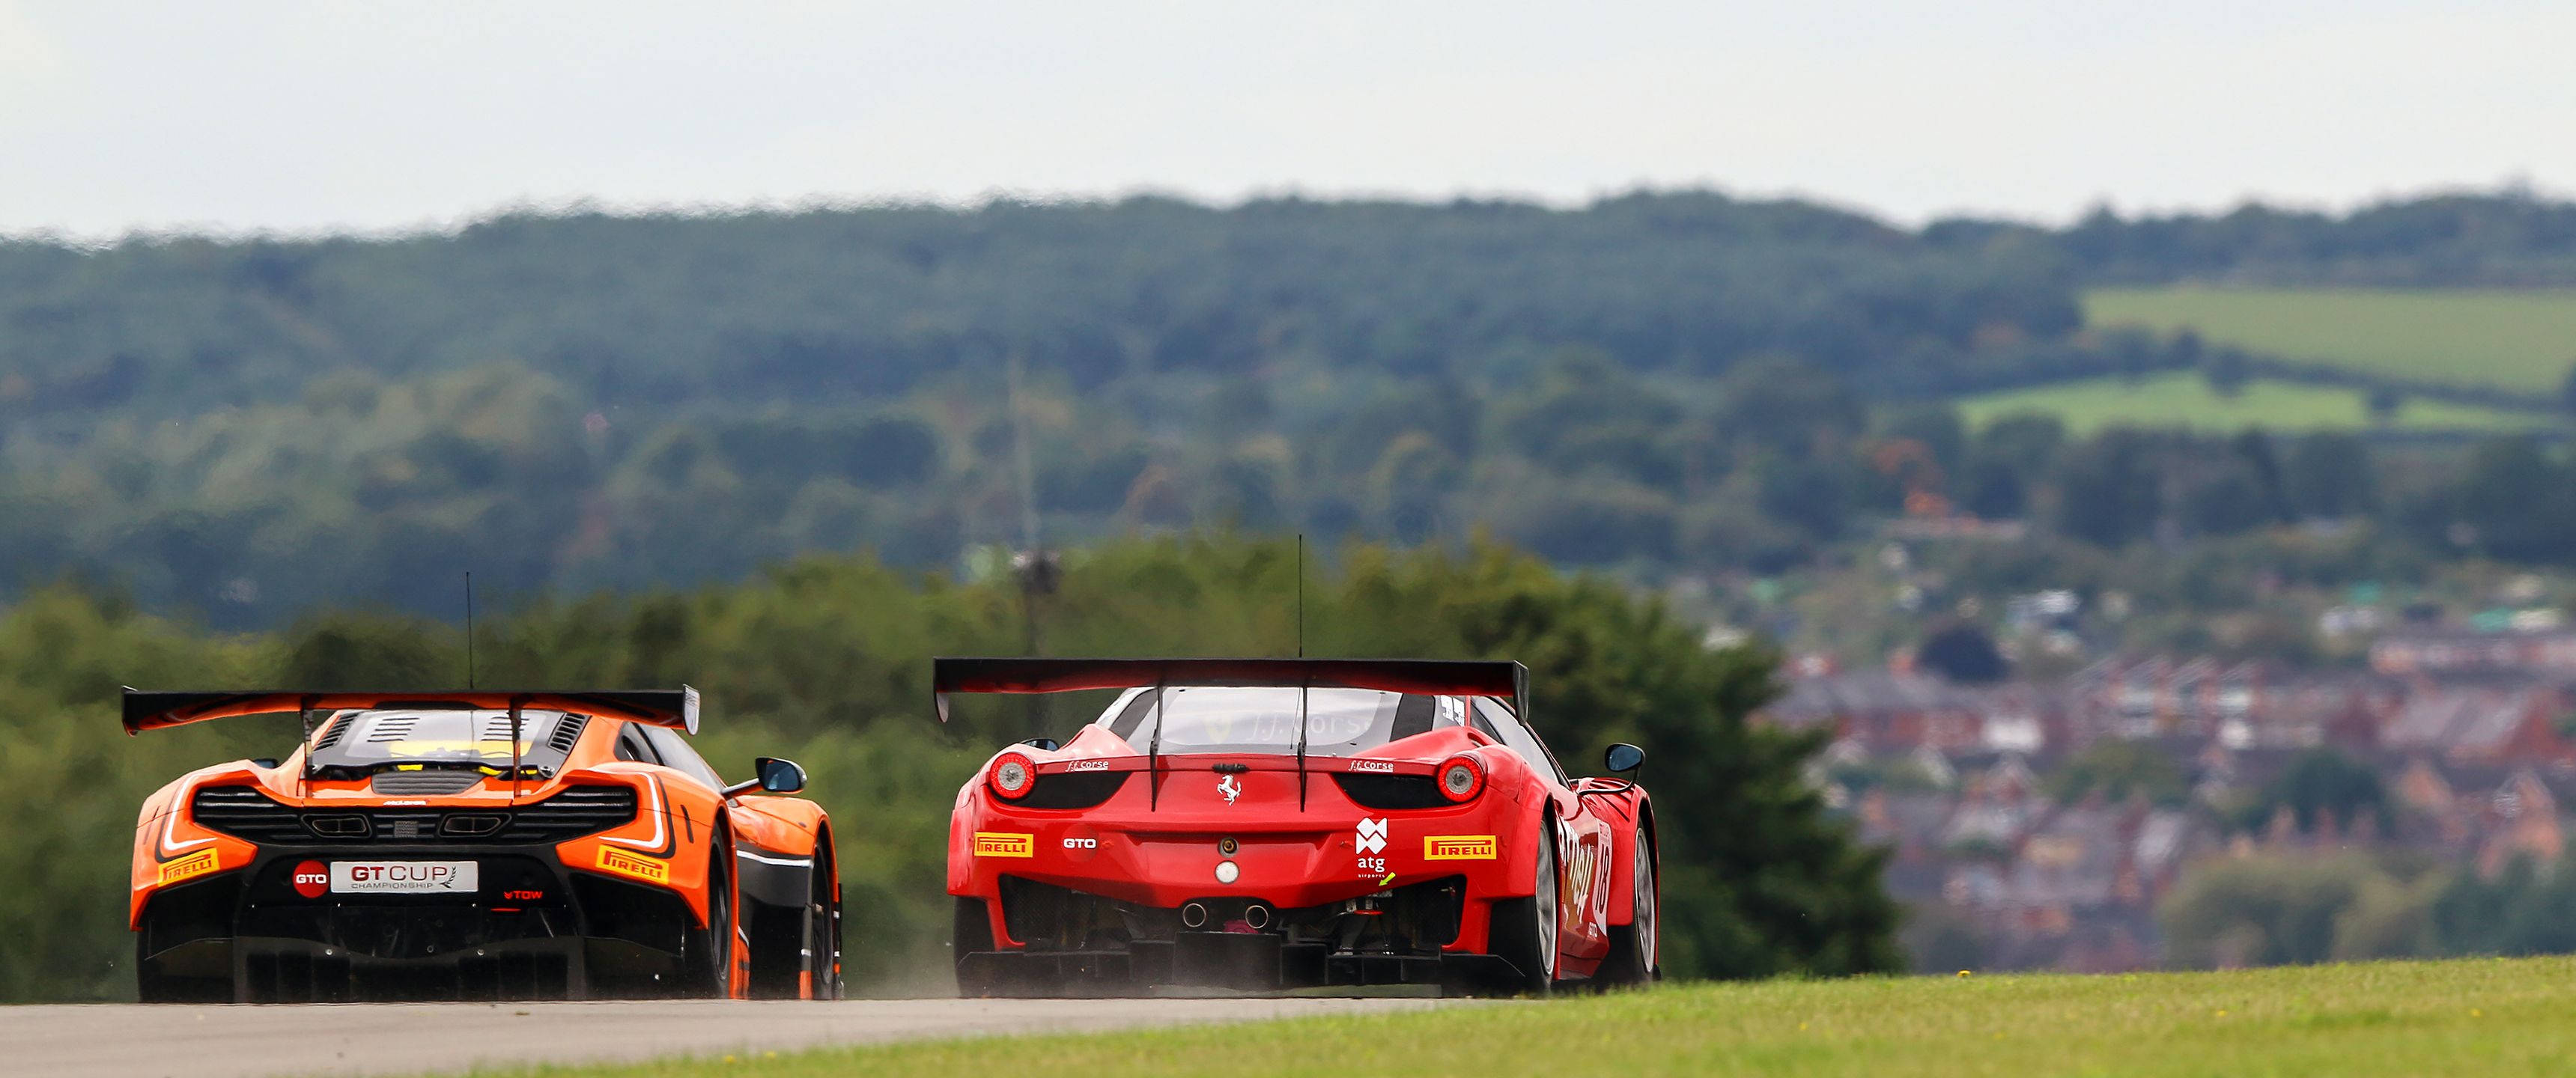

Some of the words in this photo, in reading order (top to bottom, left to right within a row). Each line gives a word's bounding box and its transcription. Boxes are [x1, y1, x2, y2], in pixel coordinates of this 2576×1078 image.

[1364, 761, 1394, 770] Corse
[977, 837, 1027, 852] PIRELLI
[1063, 838, 1096, 848] GTO
[1431, 840, 1491, 855] PIRELLI
[162, 853, 211, 881] PIRELLI
[604, 850, 663, 878] PIRELLI
[1358, 856, 1385, 873] atg
[296, 874, 327, 883] GTO
[351, 866, 384, 881] GT
[389, 866, 447, 880] CUP
[514, 891, 543, 900] TOW
